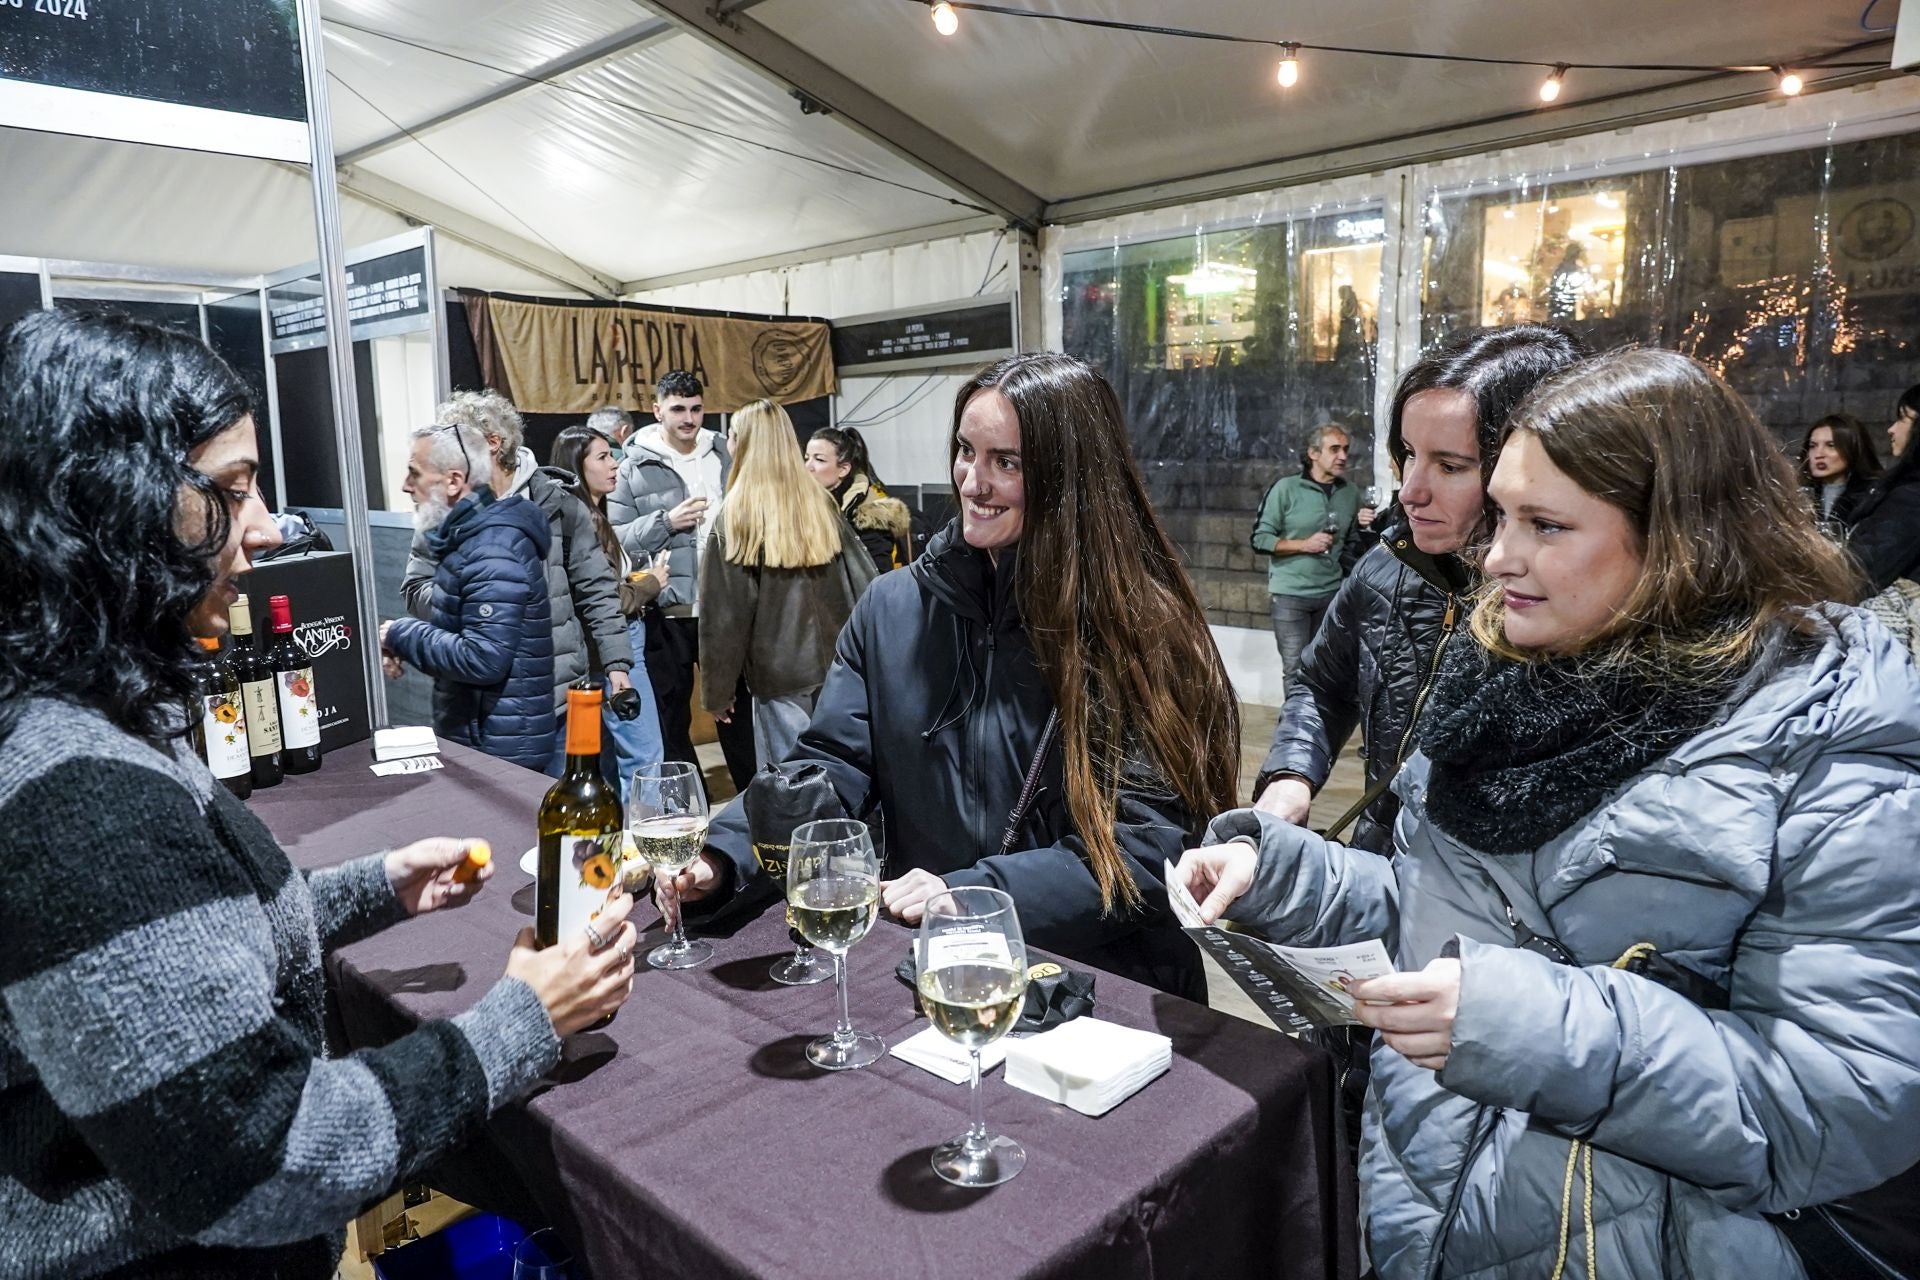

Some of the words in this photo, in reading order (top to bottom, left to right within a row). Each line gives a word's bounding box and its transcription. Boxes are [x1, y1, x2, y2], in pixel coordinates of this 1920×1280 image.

[35, 0, 88, 20] 2024
[572, 317, 608, 385] LA
[612, 312, 710, 388] PEPITA
[292, 624, 353, 658] SANTIAGO
